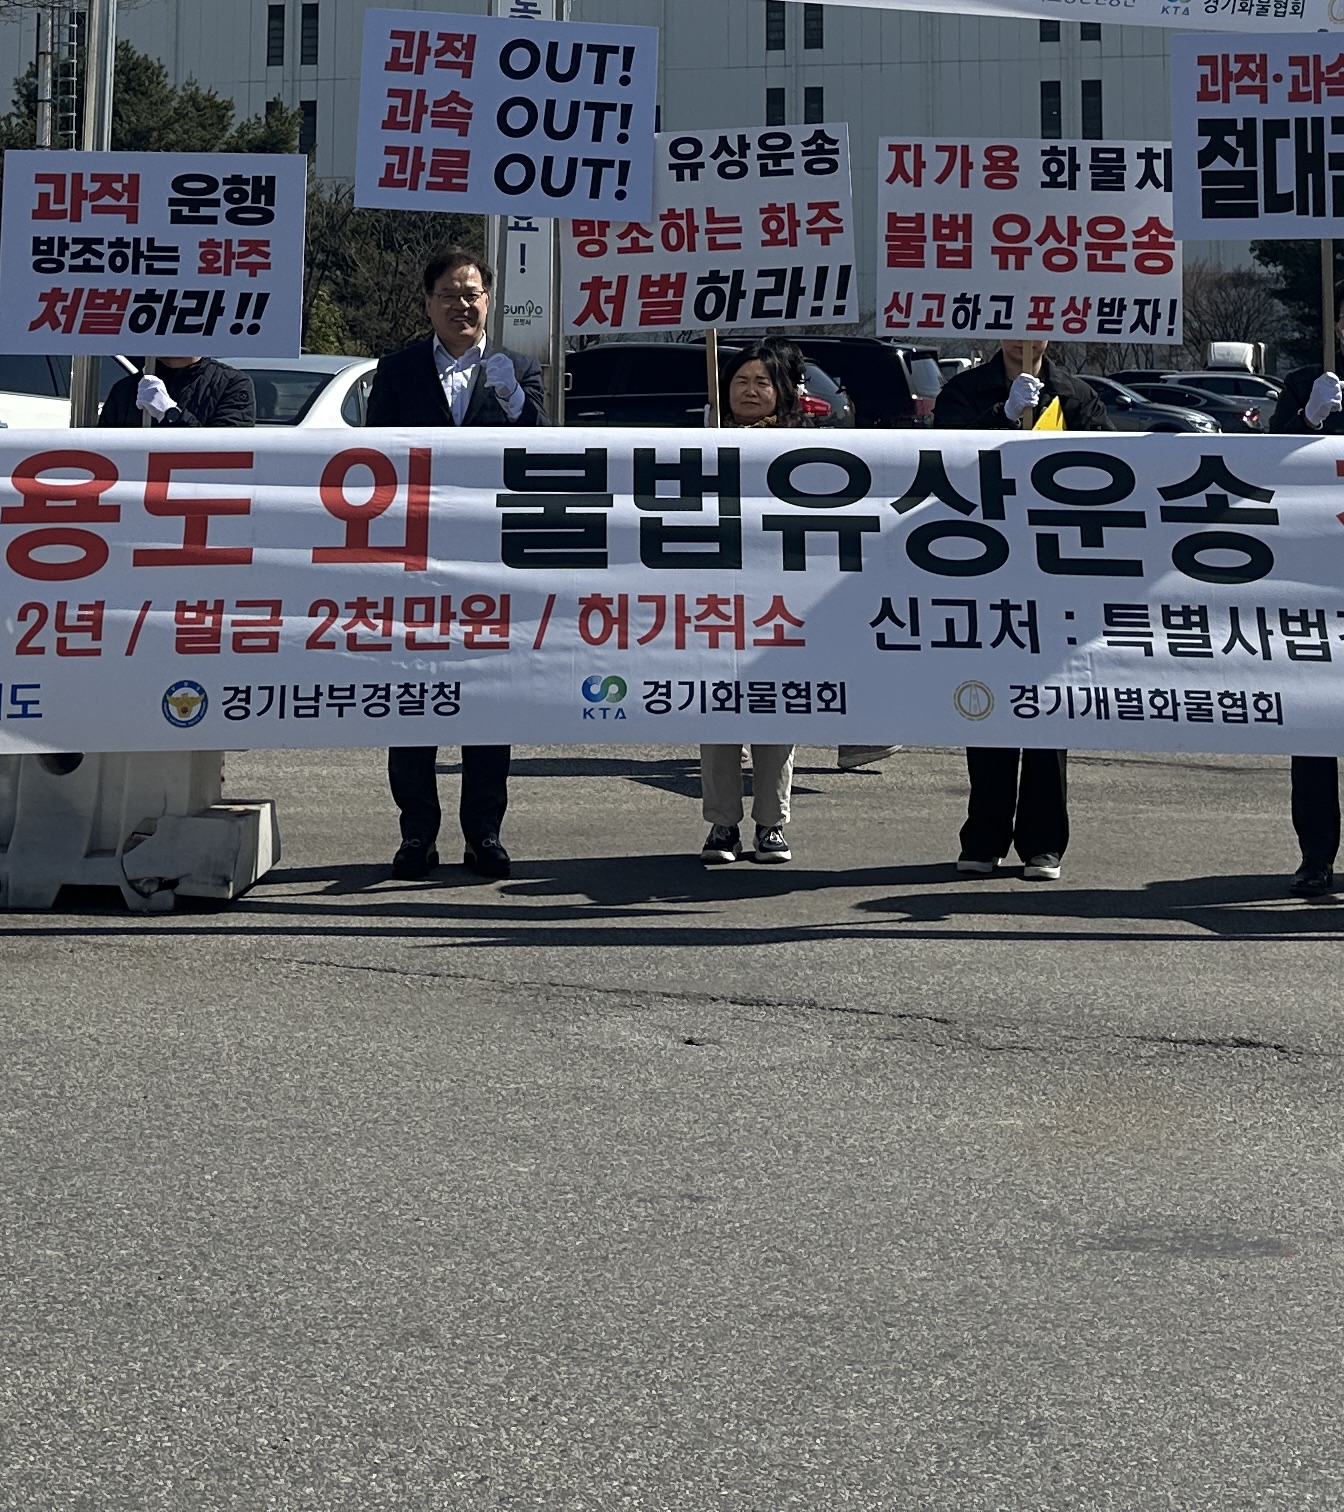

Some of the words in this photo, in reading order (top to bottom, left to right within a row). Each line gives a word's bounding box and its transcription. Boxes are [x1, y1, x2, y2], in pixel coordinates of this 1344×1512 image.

[383, 29, 478, 80] 과적
[498, 37, 637, 87] OUT!
[380, 88, 474, 137] 과속
[495, 95, 634, 145] OUT!
[378, 145, 471, 193] 과로
[493, 152, 631, 202] OUT!
[667, 128, 841, 182] 유상운송
[884, 143, 1020, 191] 자가용
[31, 172, 140, 225] 과적
[167, 173, 277, 226] 운행
[759, 200, 845, 249] 화주
[31, 235, 181, 276] 방조하는
[197, 238, 272, 278] 화주
[884, 212, 973, 270] 불법
[990, 213, 1176, 275] 유상운송
[572, 263, 853, 328] 처벌하라!!
[883, 291, 1015, 331] 신고하고
[1025, 295, 1178, 337] 포상받자!
[0, 448, 255, 582] 용도
[311, 447, 433, 572] 외
[495, 446, 1280, 585] 불법유상운송
[16, 599, 105, 659] 2년
[173, 598, 284, 657] 벌금
[305, 594, 512, 653] 2천만원
[576, 593, 807, 652] 허가취소
[868, 596, 1041, 655] 신고처
[221, 681, 462, 722] 경기남부경찰청
[581, 707, 627, 721] KTA
[641, 679, 848, 715] 경기화물협회
[1008, 682, 1285, 727] 경기개별화물협회
